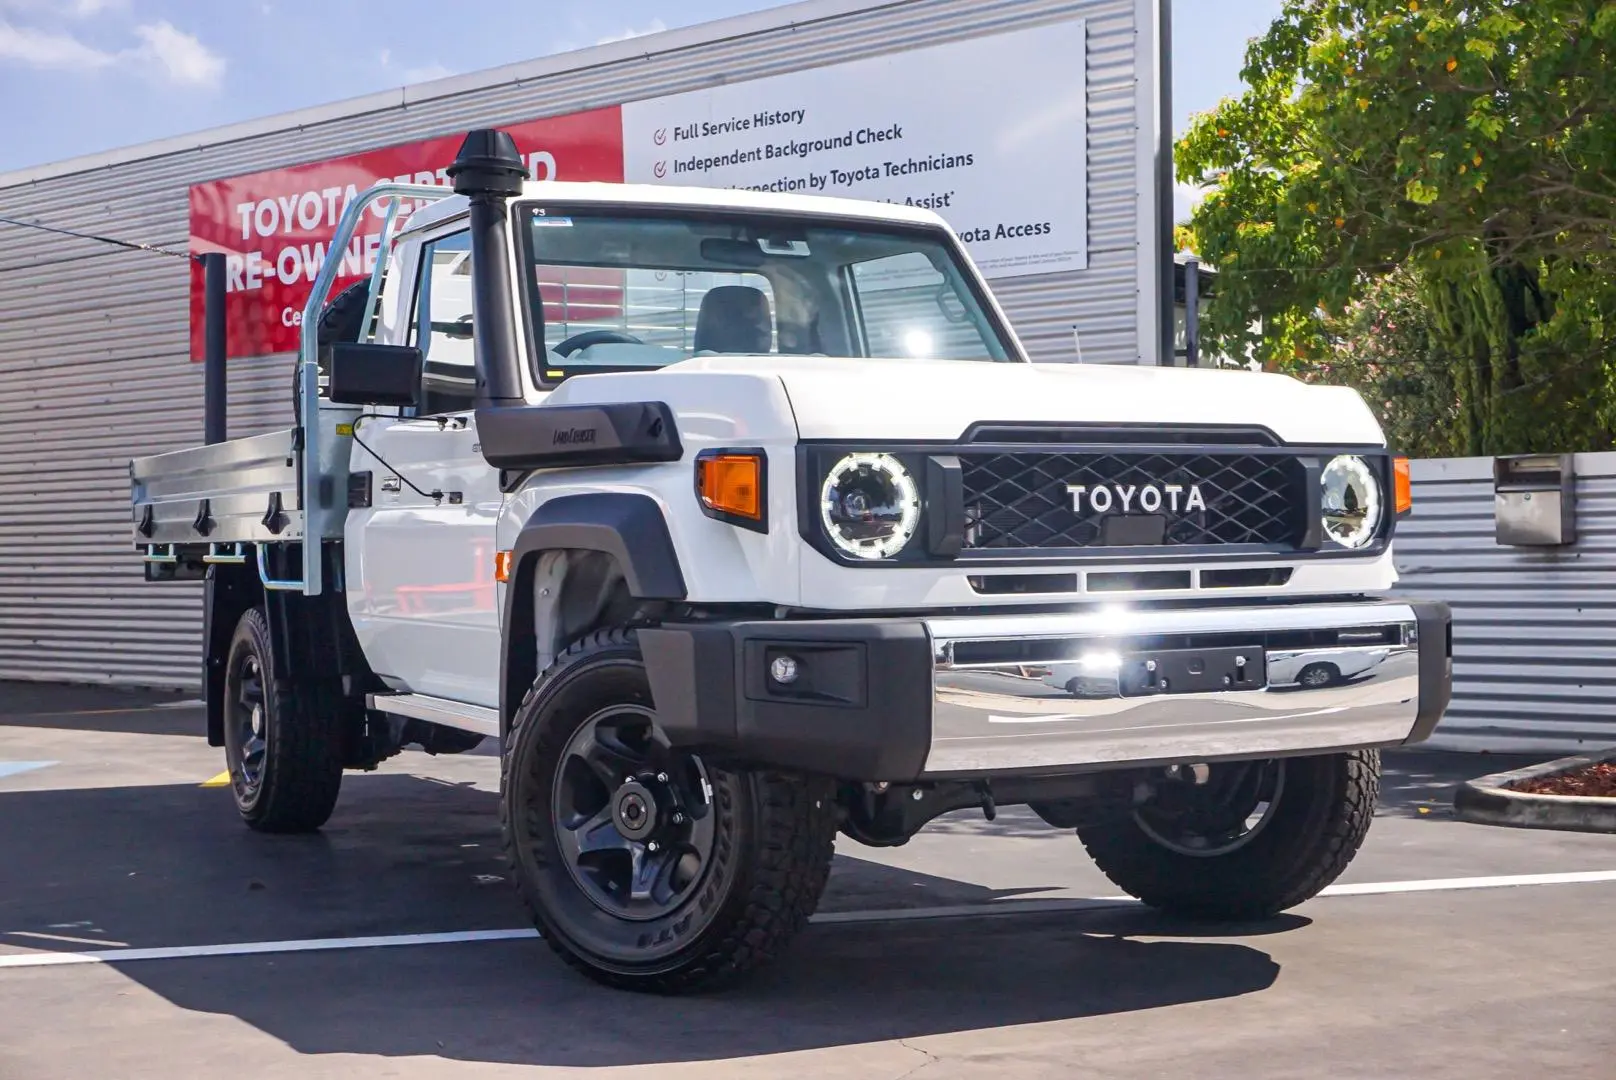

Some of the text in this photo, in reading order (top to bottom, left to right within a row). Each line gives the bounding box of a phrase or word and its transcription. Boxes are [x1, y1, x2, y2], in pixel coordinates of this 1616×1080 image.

[674, 109, 805, 141] Full Service History
[674, 124, 903, 173] Independent Background Check
[810, 173, 827, 191] by
[830, 166, 880, 187] Toyota
[884, 152, 974, 177] Technicians
[955, 221, 1051, 243] yota Access
[226, 233, 382, 293] RE-OWNE
[1066, 484, 1207, 512] TOYOTA
